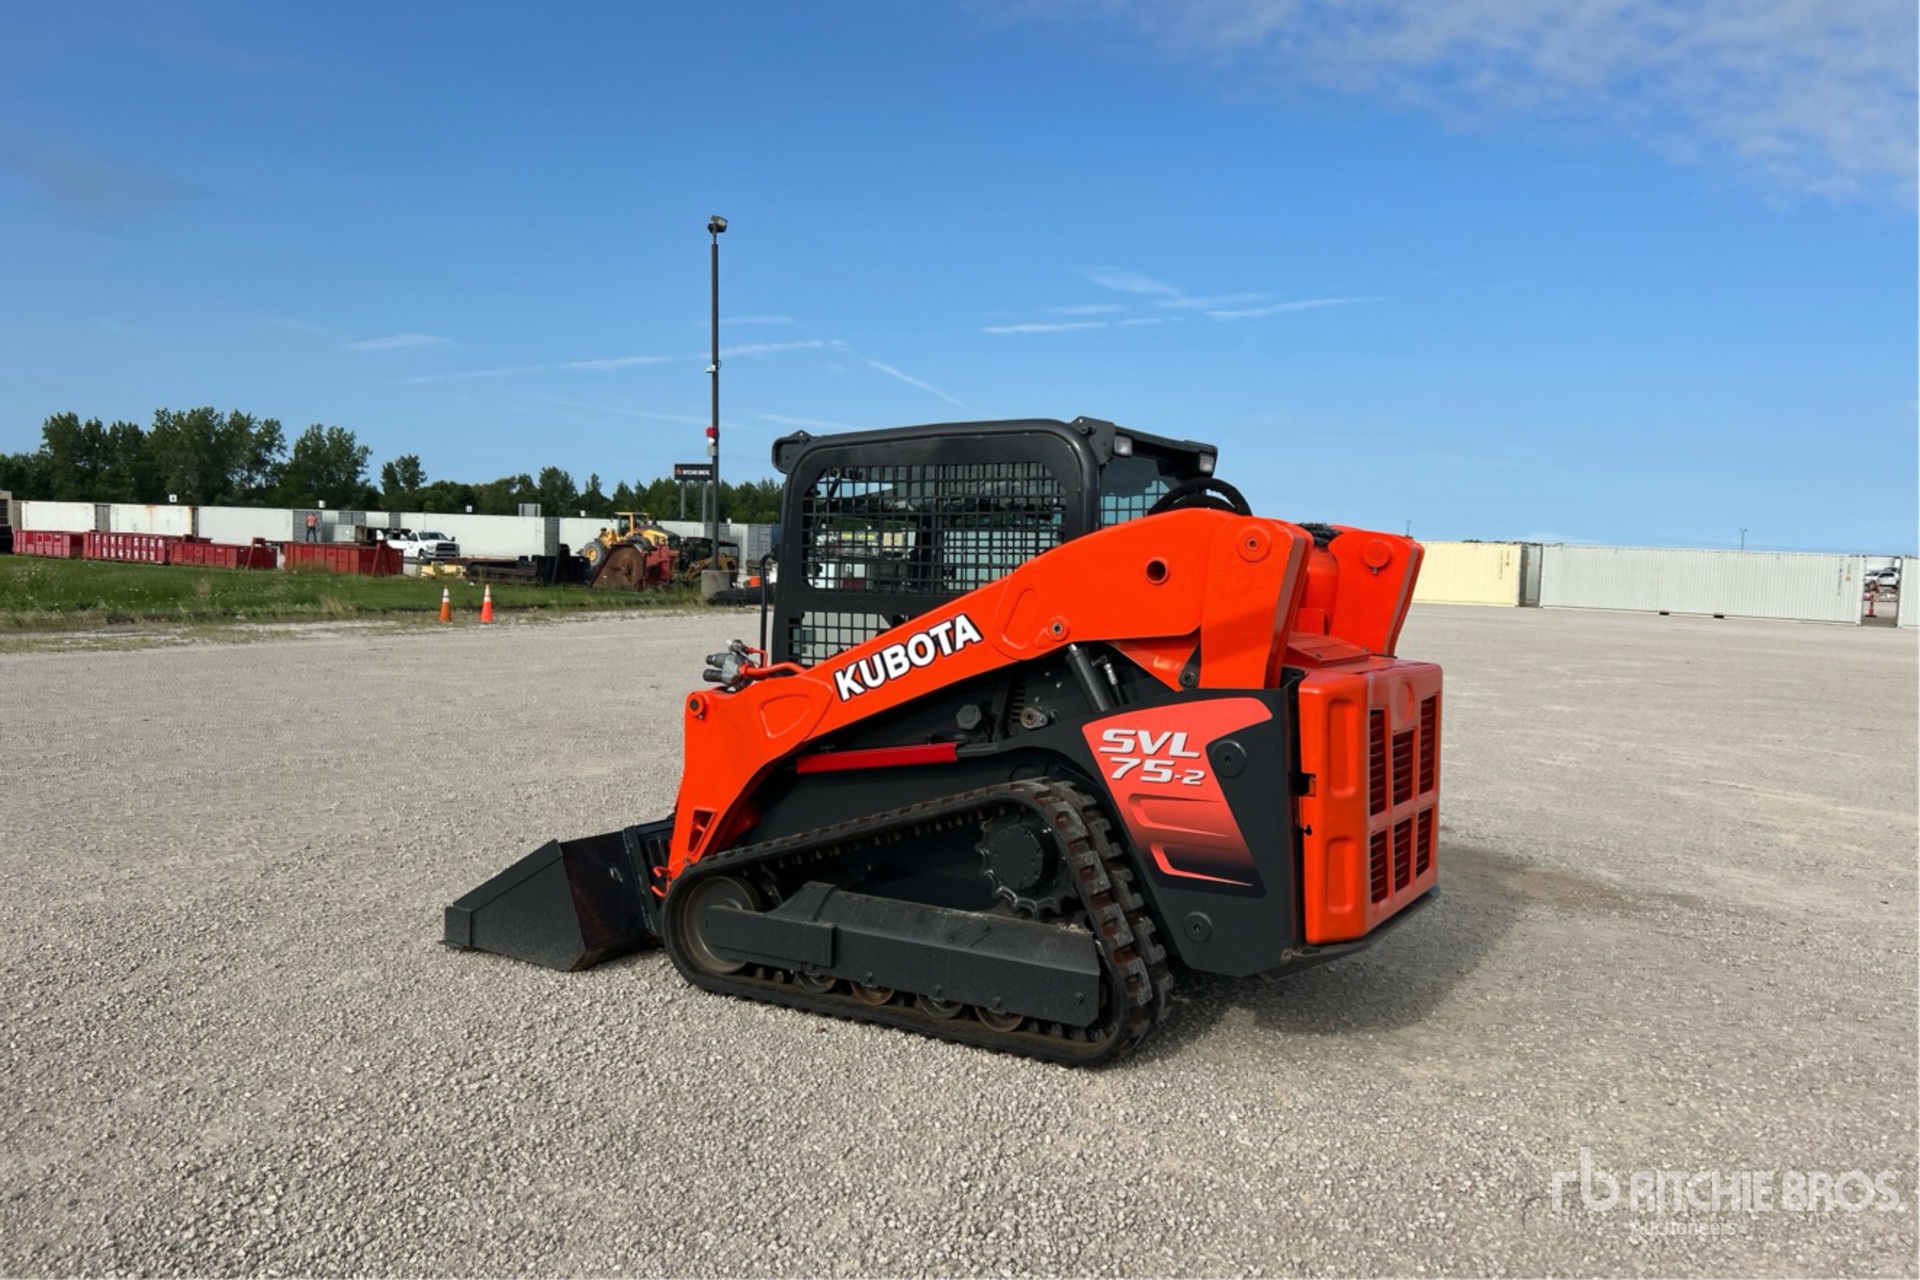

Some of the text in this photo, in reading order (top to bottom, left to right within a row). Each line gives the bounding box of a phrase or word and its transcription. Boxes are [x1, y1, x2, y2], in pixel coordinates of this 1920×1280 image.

[95, 534, 123, 545] FIVE
[834, 613, 984, 701] KUBOTA
[1099, 728, 1201, 758] SVL
[1110, 756, 1206, 785] 75-2
